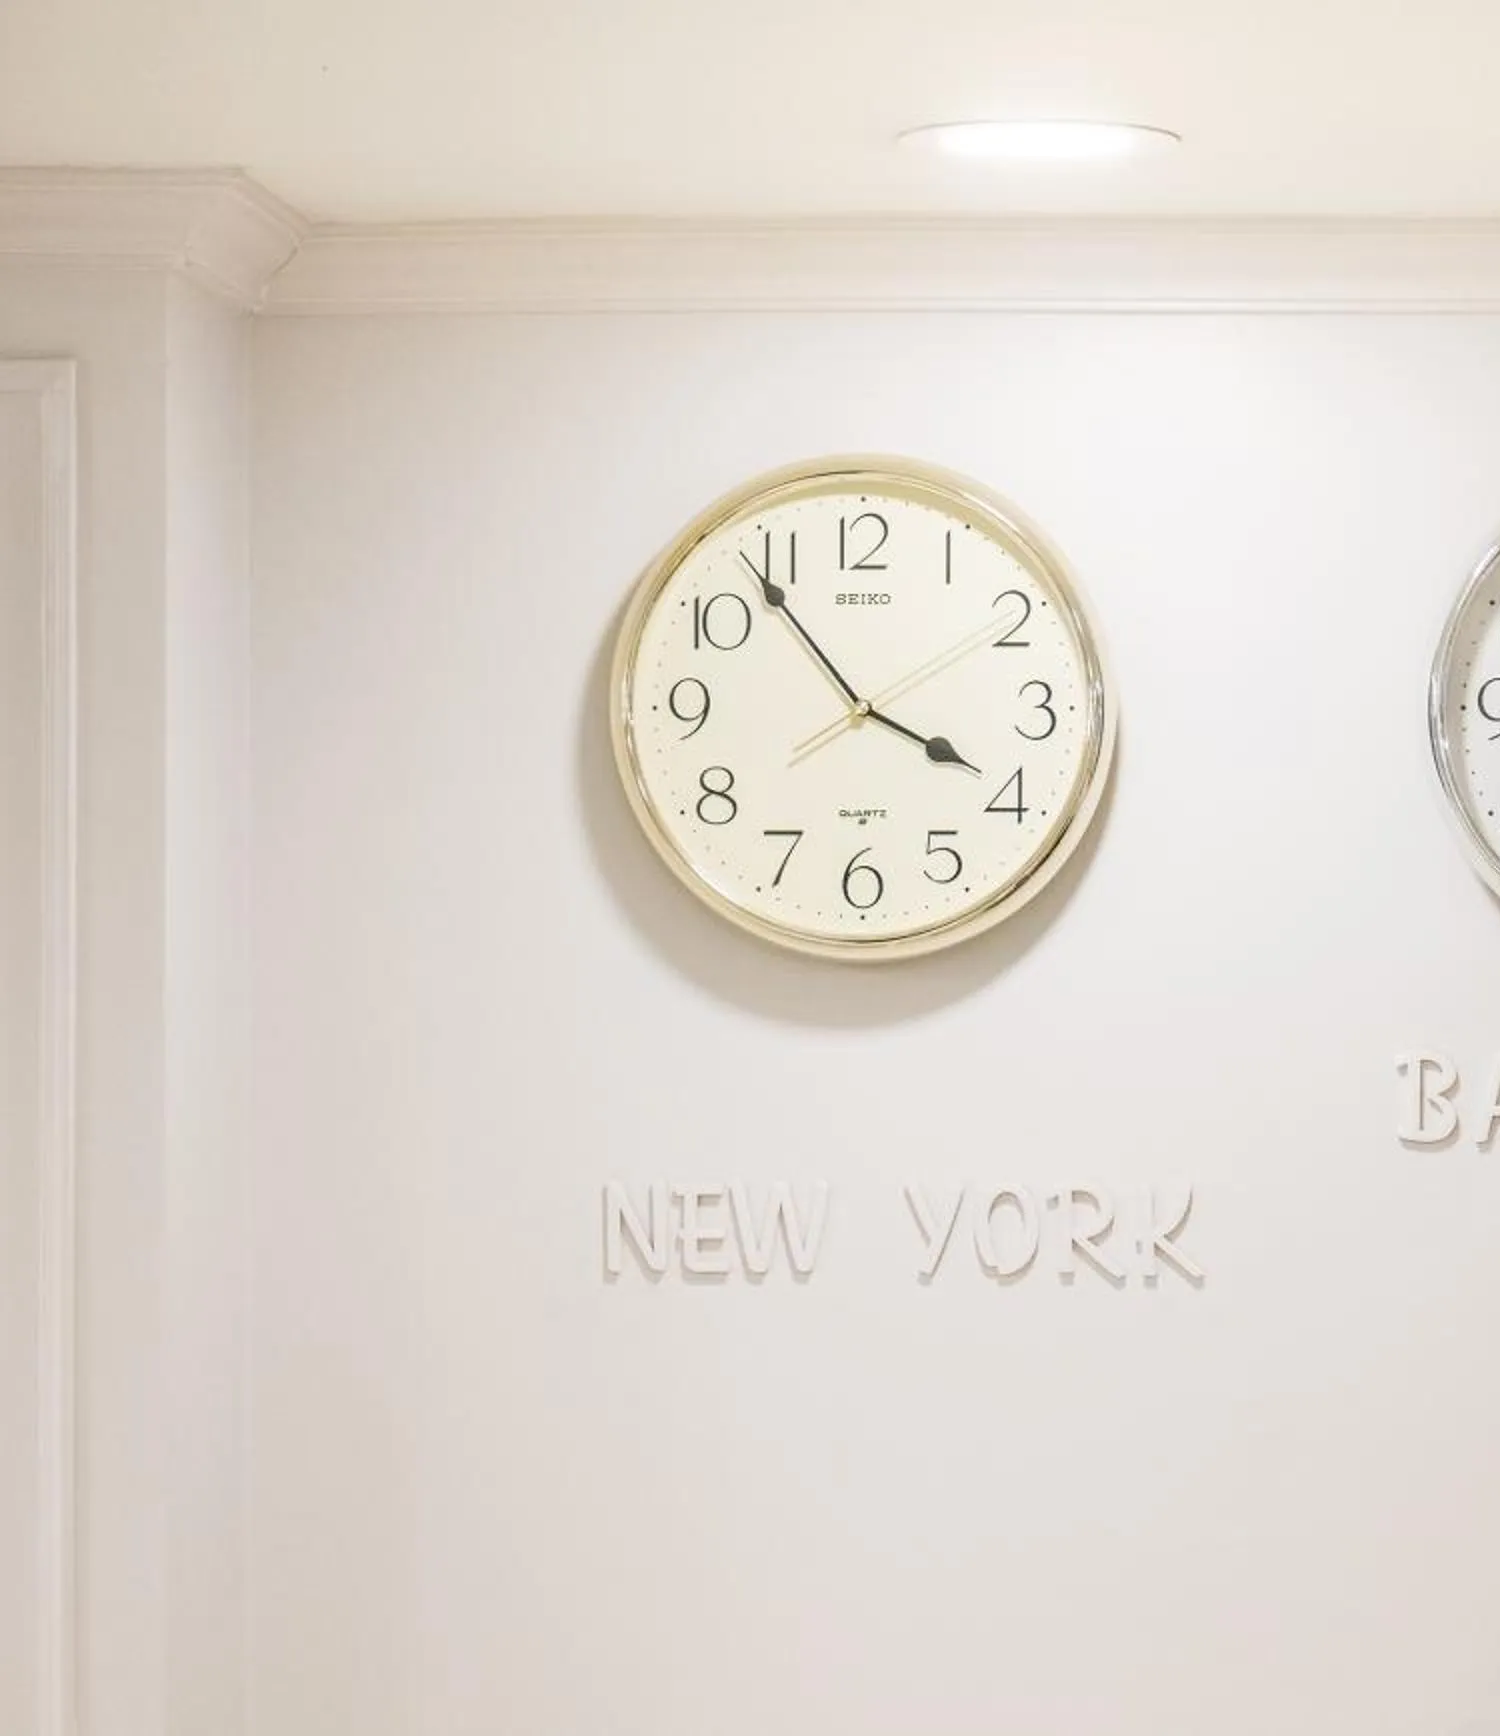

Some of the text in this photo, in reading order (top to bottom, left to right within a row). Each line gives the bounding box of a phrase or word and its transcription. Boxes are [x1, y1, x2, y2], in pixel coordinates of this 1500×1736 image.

[764, 531, 796, 585] 11
[840, 512, 889, 570] 12
[945, 531, 951, 585] 1
[693, 592, 752, 650] 10
[835, 593, 892, 605] SEIKO
[991, 589, 1031, 647] 2
[668, 677, 711, 741] 9
[1014, 680, 1057, 740] 3
[696, 766, 739, 825] 8
[838, 809, 888, 818] QUARTZ
[983, 767, 1029, 823] 4
[763, 830, 804, 887] 7
[841, 847, 884, 909] 6
[923, 831, 963, 883] 5
[602, 1178, 1206, 1283] NEW YORK
